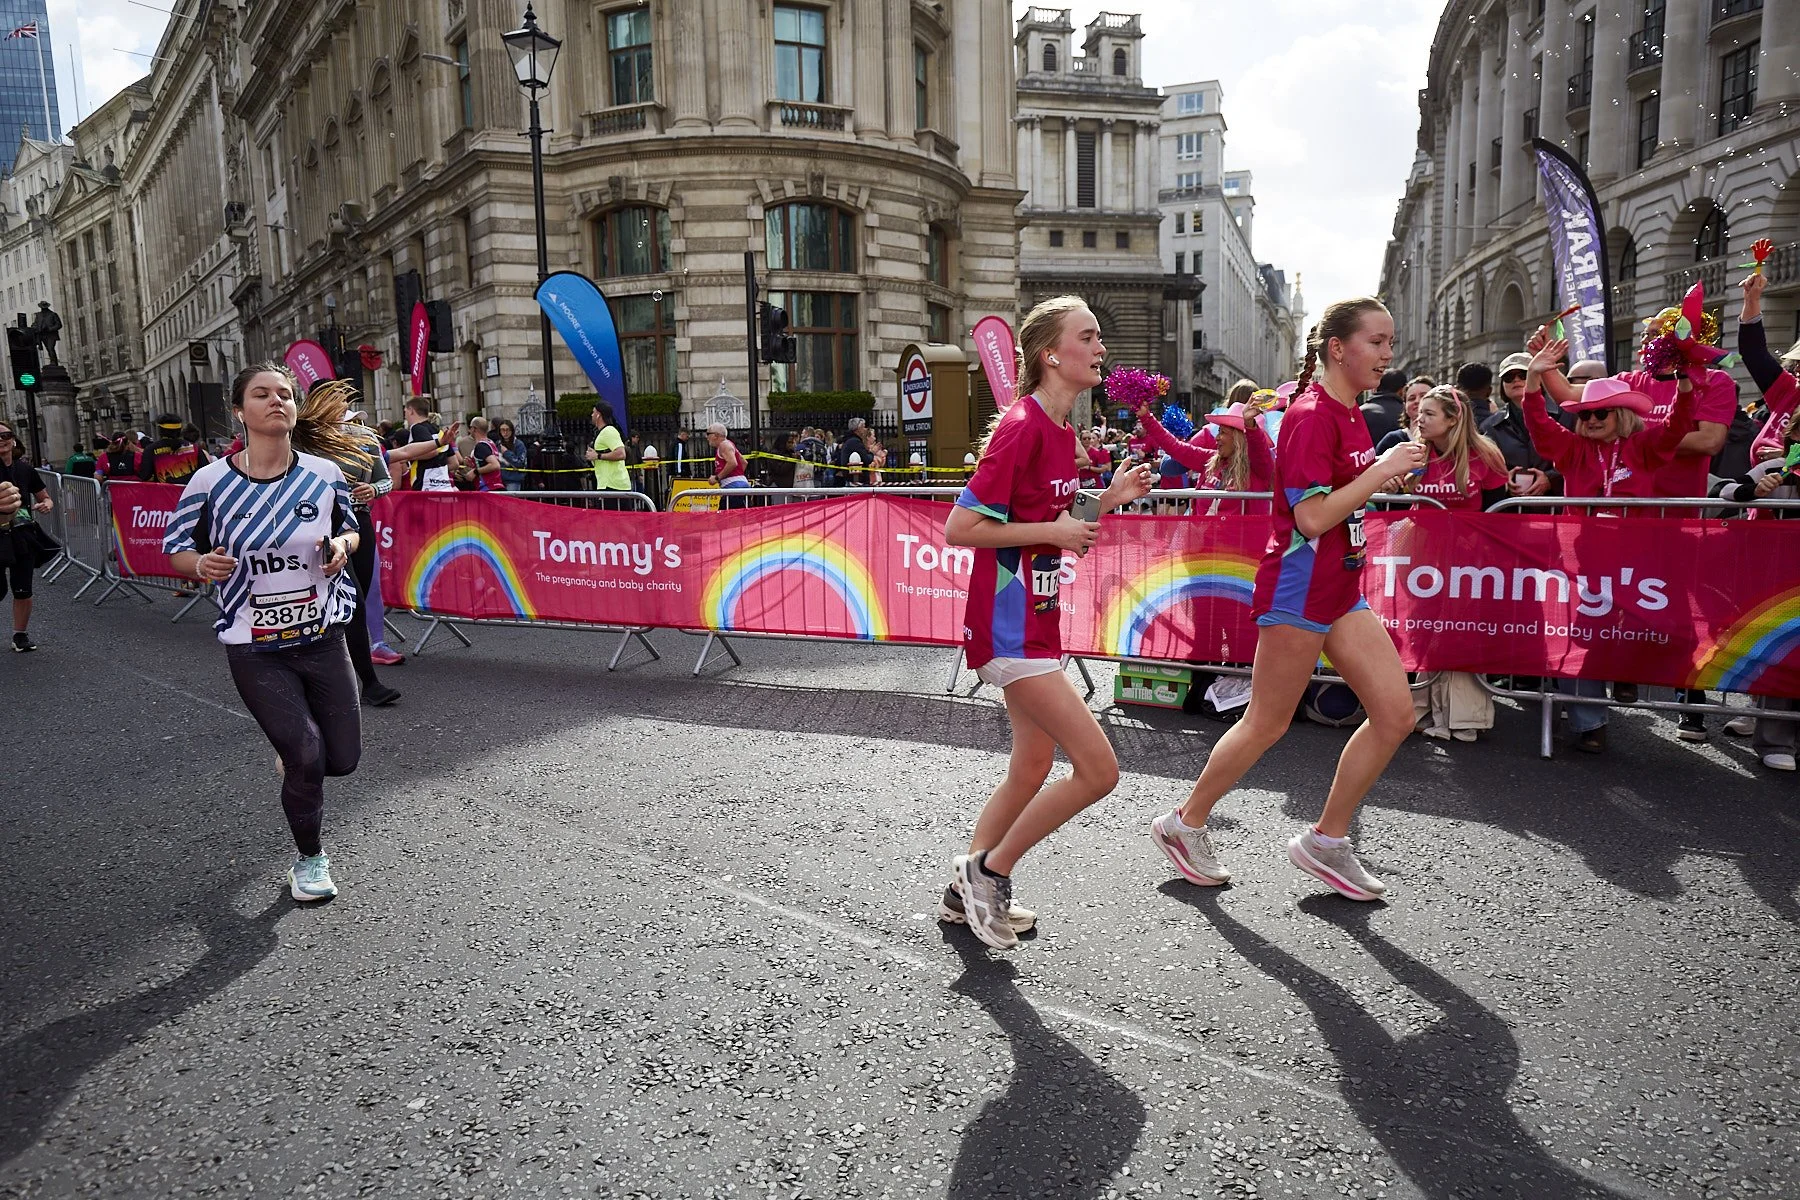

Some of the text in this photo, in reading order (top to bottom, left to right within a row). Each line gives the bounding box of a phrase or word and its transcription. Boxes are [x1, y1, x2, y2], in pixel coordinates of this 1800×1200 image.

[413, 319, 425, 377] Tommy's
[560, 302, 611, 379] MOORE Kingston Smith
[904, 379, 930, 393] UNDERGROUND
[905, 422, 931, 432] BANK STATION
[250, 552, 308, 576] hbs.
[532, 530, 682, 575] Tommy's
[536, 572, 682, 593] The pregnancy and baby charity
[896, 582, 914, 593] The
[1372, 556, 1669, 617] Tommy's
[253, 601, 318, 627] 23875
[1405, 617, 1498, 636] pregnancy
[1503, 621, 1538, 635] and
[1544, 621, 1593, 642] baby
[1600, 626, 1670, 645] charity
